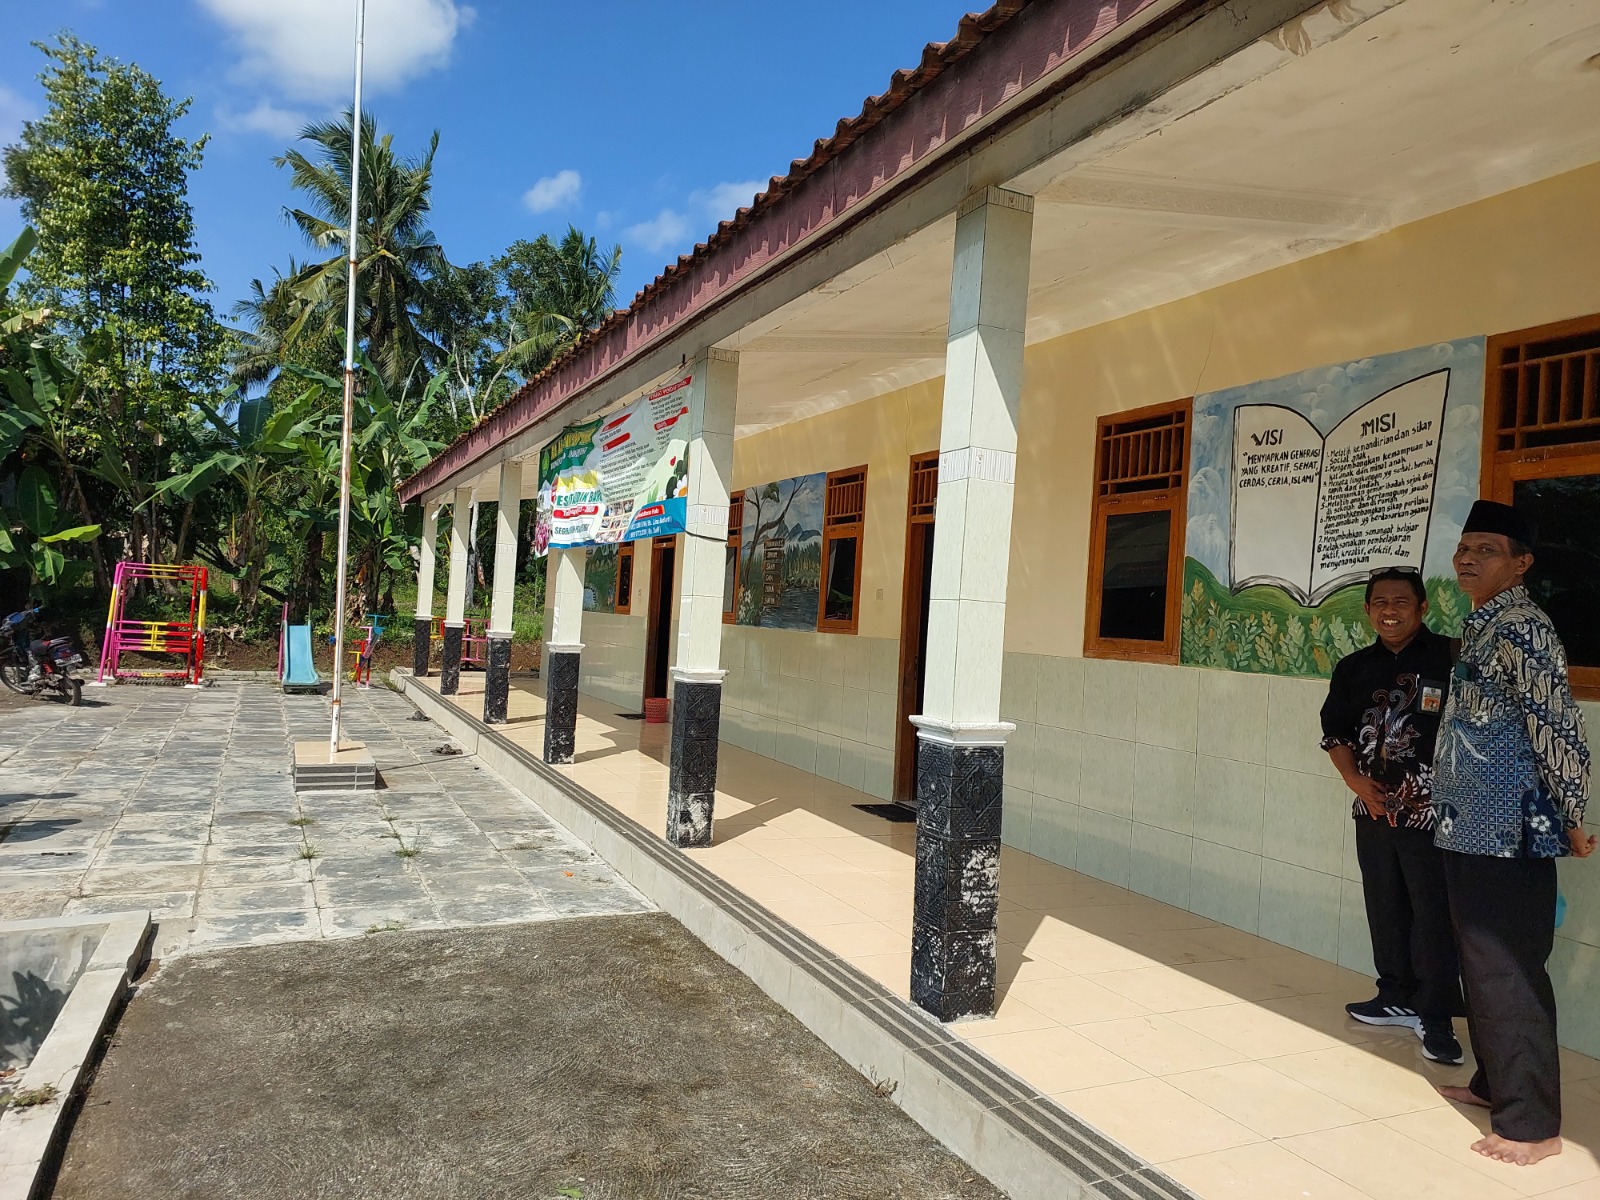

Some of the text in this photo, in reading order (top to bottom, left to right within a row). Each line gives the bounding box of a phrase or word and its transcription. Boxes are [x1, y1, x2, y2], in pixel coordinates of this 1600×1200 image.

[1361, 412, 1396, 438] MISI
[1394, 429, 1409, 441] dan
[1411, 420, 1433, 435] sikap
[1251, 429, 1283, 446] VISI
[1290, 449, 1321, 460] GENERASI
[1382, 443, 1424, 461] kemampuan
[1241, 466, 1258, 477] YANG
[1403, 495, 1429, 510] perilaku
[1360, 516, 1369, 527] yg
[1370, 510, 1409, 523] berdasarkan
[1365, 523, 1395, 537] semangat
[1396, 521, 1420, 535] belajar
[1367, 533, 1411, 547] pembelajaran
[1394, 544, 1410, 558] dan
[1320, 555, 1370, 572] menyenangkan
